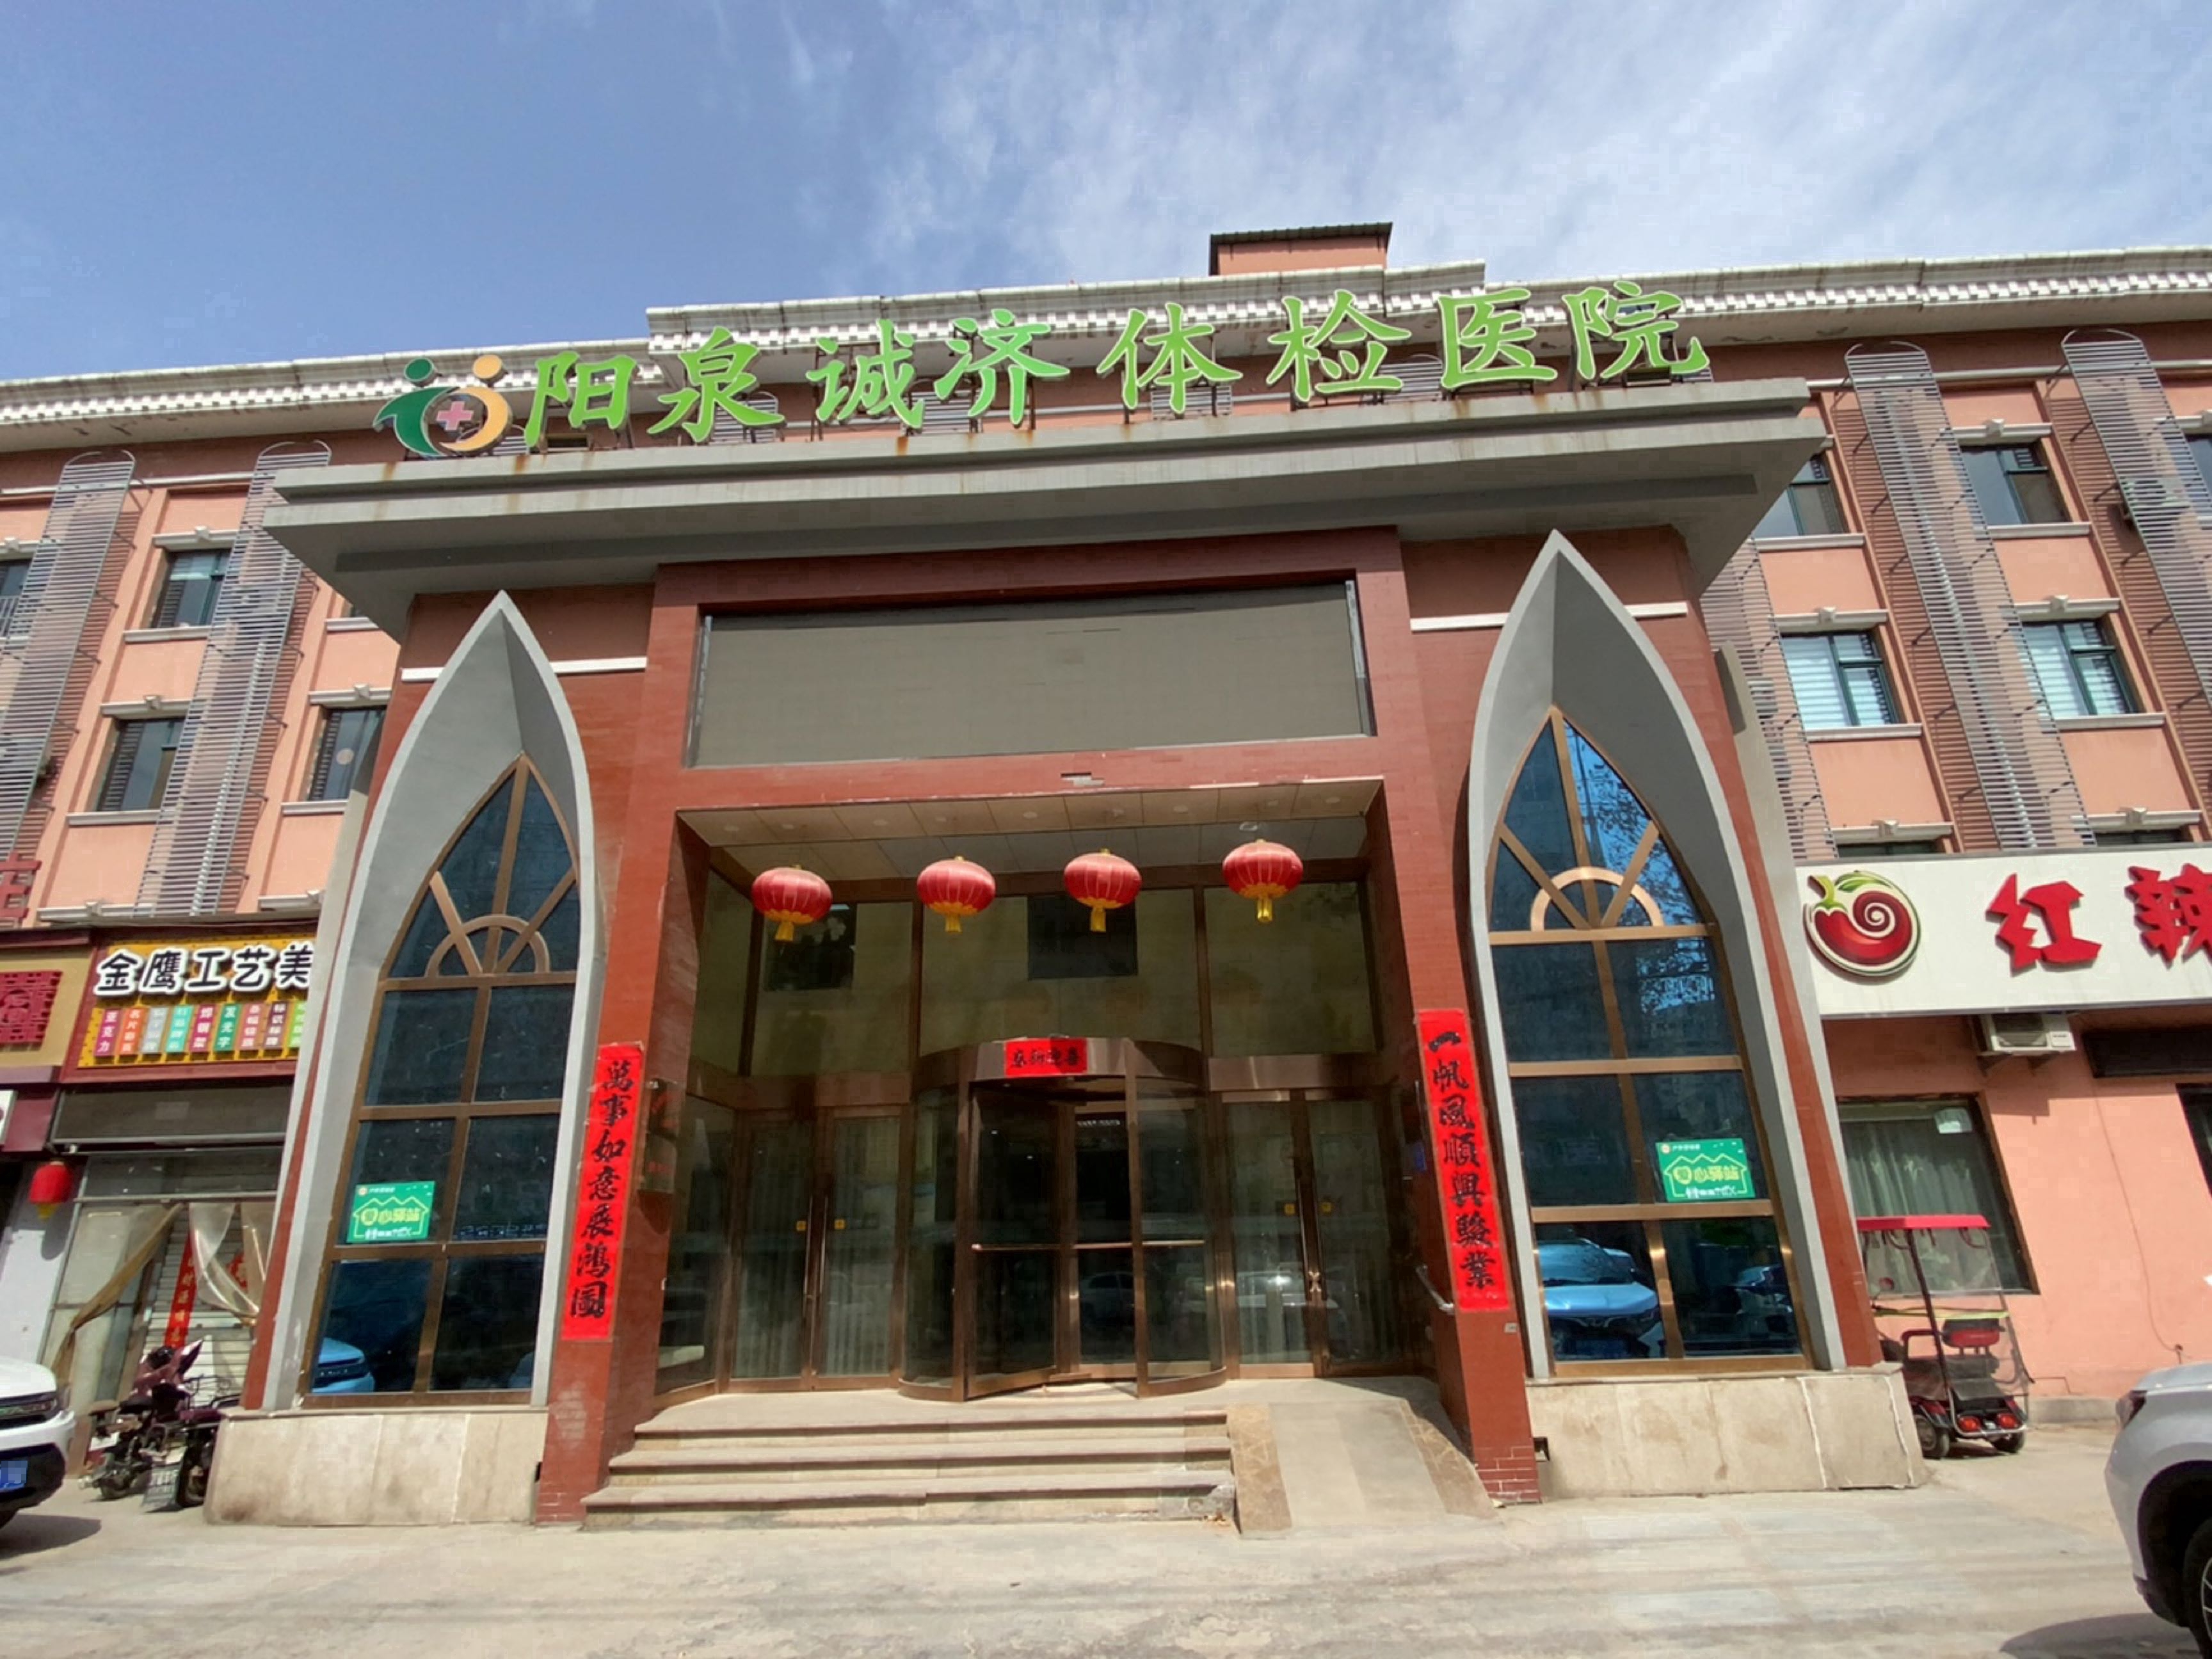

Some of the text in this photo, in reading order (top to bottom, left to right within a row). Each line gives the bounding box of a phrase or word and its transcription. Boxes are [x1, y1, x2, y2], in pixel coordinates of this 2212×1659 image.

[525, 282, 1710, 447] 阳泉诚济体检医院
[94, 939, 314, 997] 金鹰工艺美
